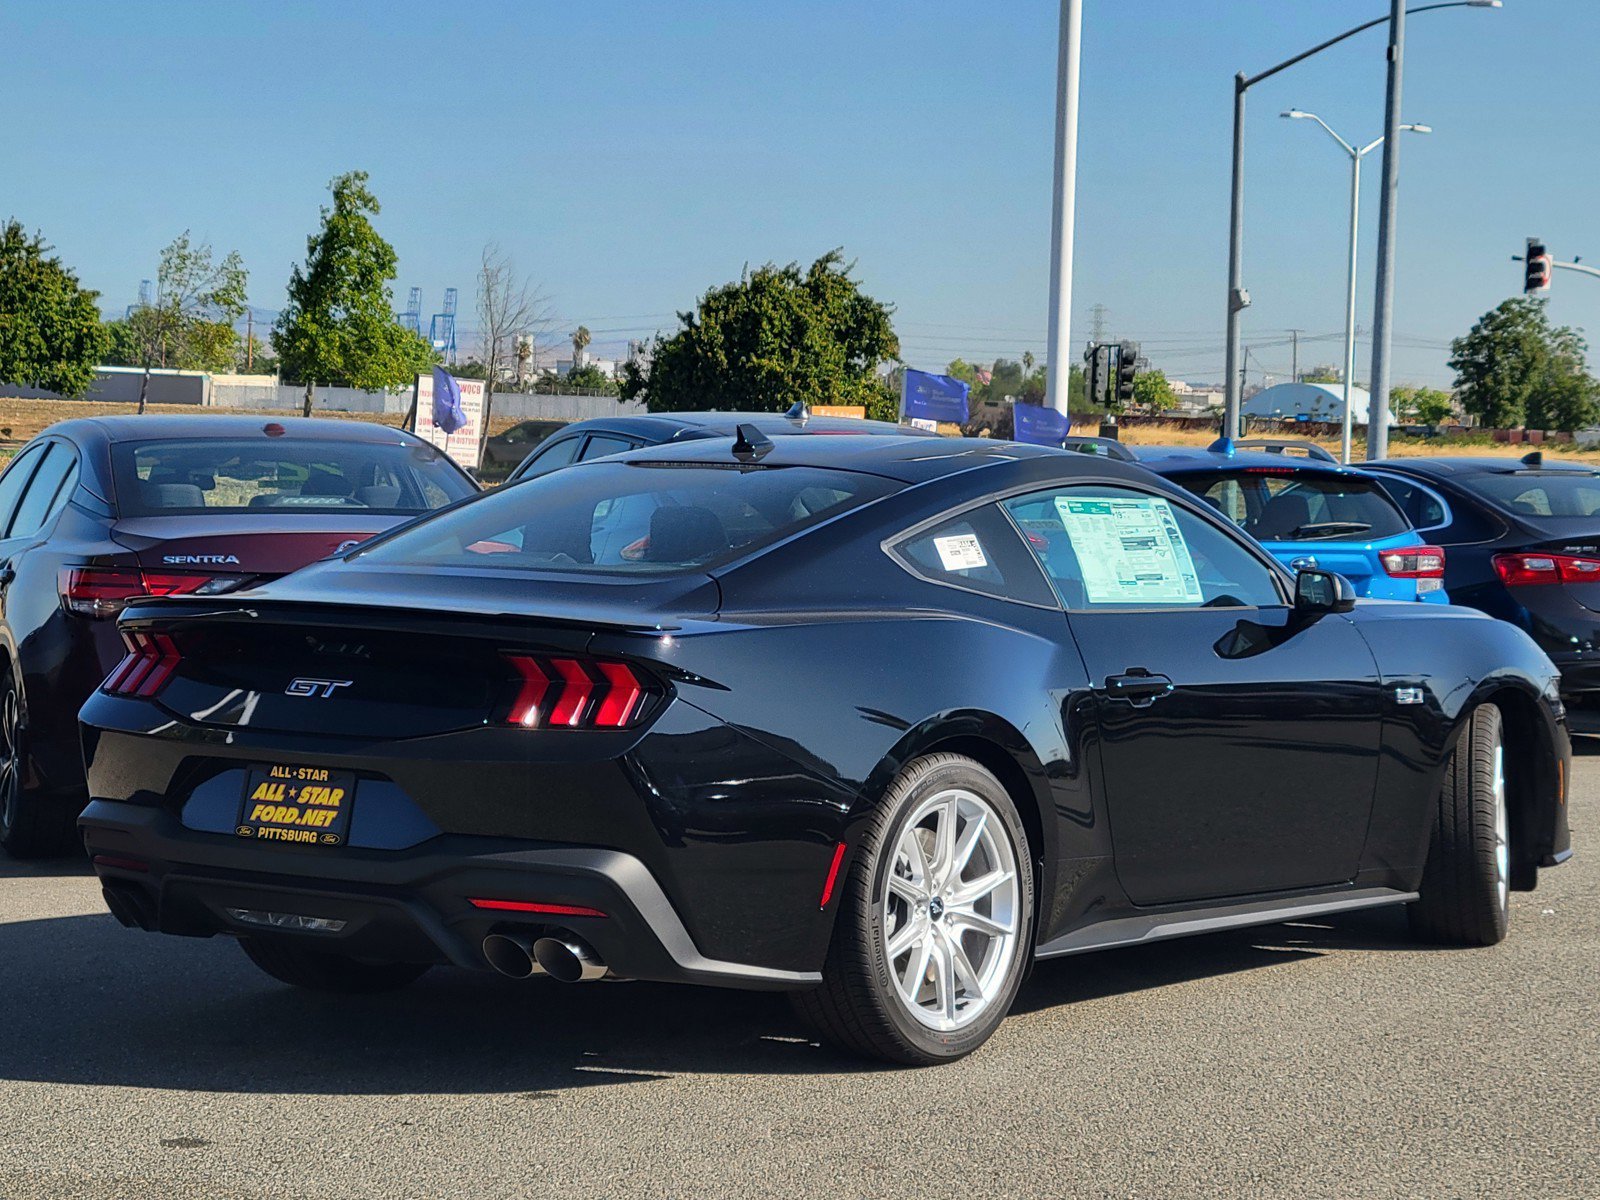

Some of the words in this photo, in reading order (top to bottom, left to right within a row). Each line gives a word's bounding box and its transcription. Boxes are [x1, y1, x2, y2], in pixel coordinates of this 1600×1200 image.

[163, 555, 240, 564] SENTRA
[285, 677, 353, 698] GT
[249, 804, 338, 827] FORD.NET
[257, 827, 317, 843] PITTSBURG
